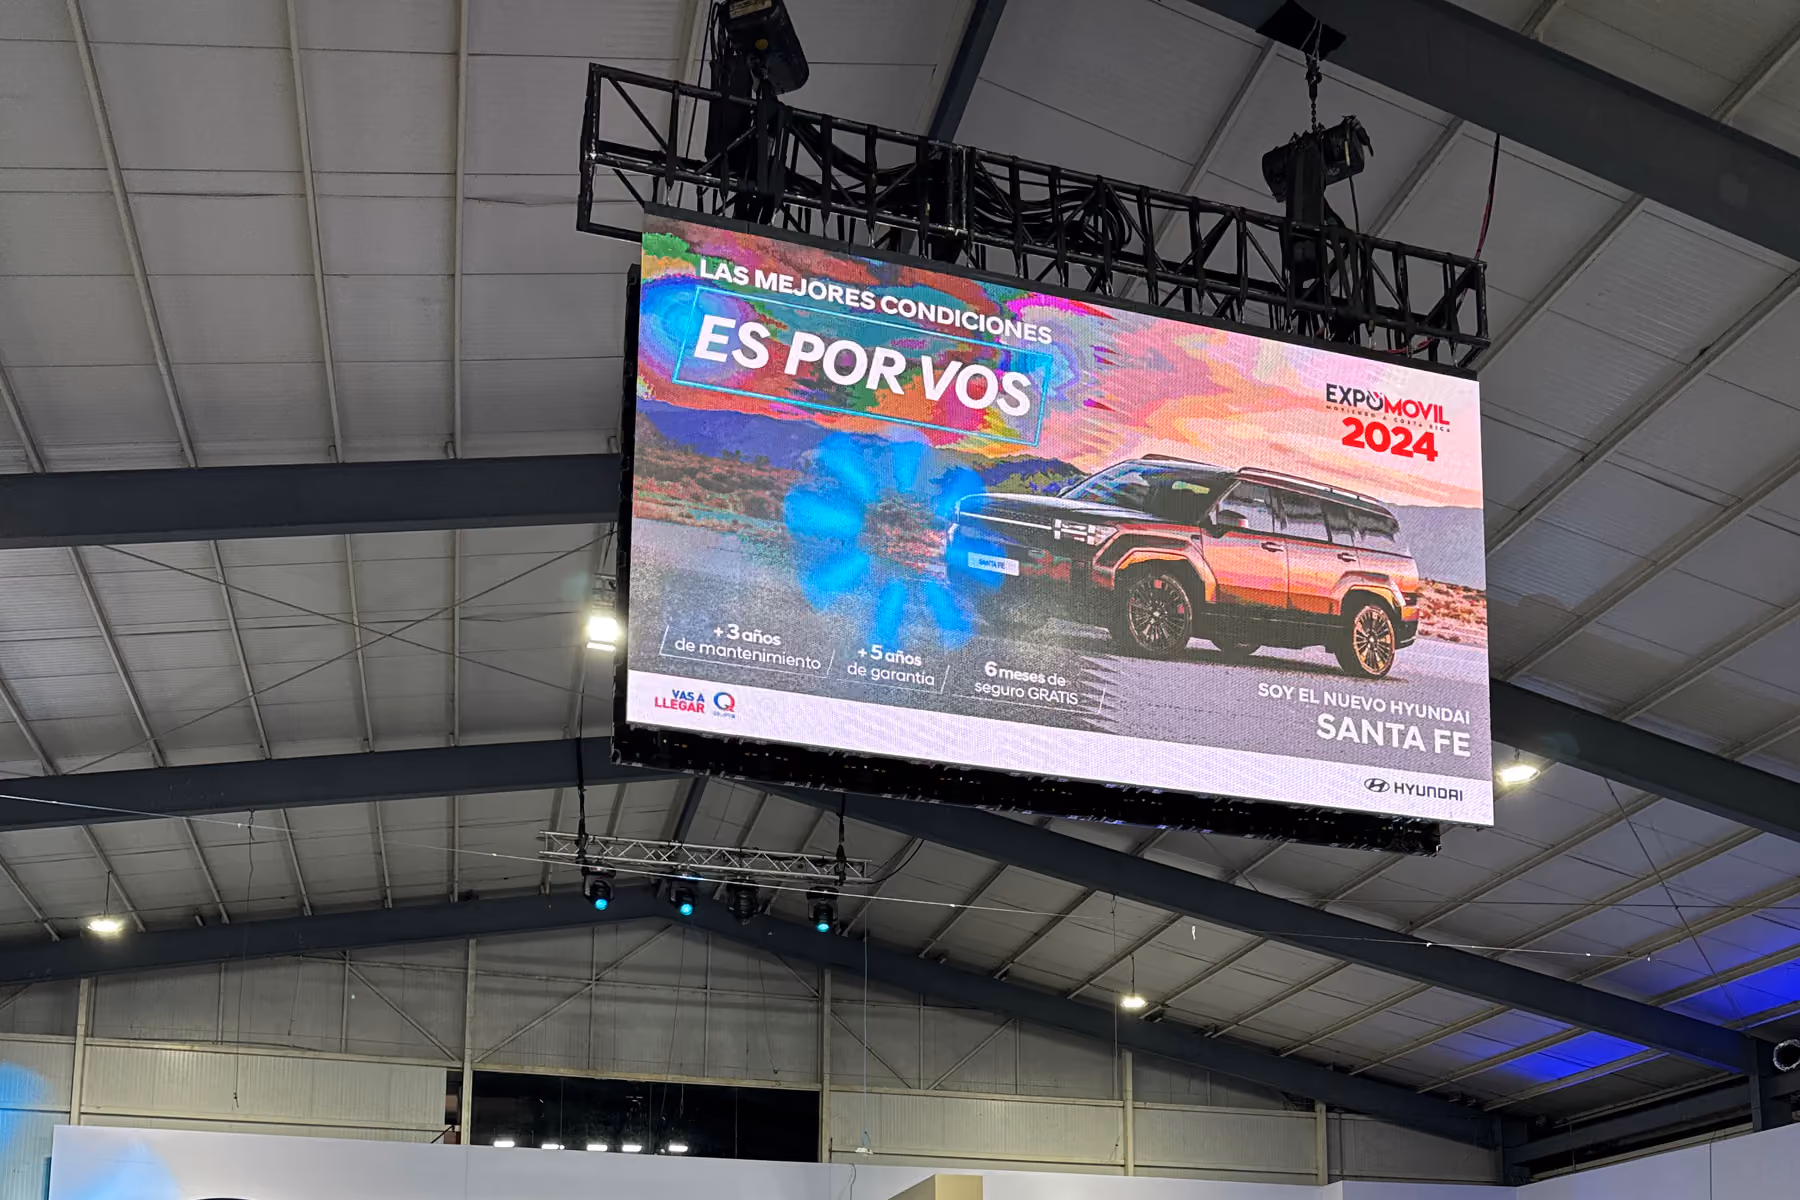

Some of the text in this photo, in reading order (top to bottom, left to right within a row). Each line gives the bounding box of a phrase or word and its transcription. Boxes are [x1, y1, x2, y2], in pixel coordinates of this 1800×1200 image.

[700, 259, 1052, 345] LAS MEJORES CONDICIONES
[694, 314, 1032, 417] ES POR VOS
[1342, 417, 1438, 462] 2024
[742, 629, 781, 645] años
[675, 638, 821, 670] de mantenimiento
[885, 650, 922, 666] años
[847, 662, 935, 686] de garantía
[984, 661, 1066, 687] 6 meses de
[655, 697, 705, 714] LLEGAR
[672, 689, 705, 703] VAS A
[975, 681, 1078, 705] seguro GRATIS
[1258, 683, 1470, 725] SOY EL NUEVO HYUNDAI
[1316, 713, 1471, 757] SANTA FE
[1394, 782, 1463, 801] HYUNDAI
